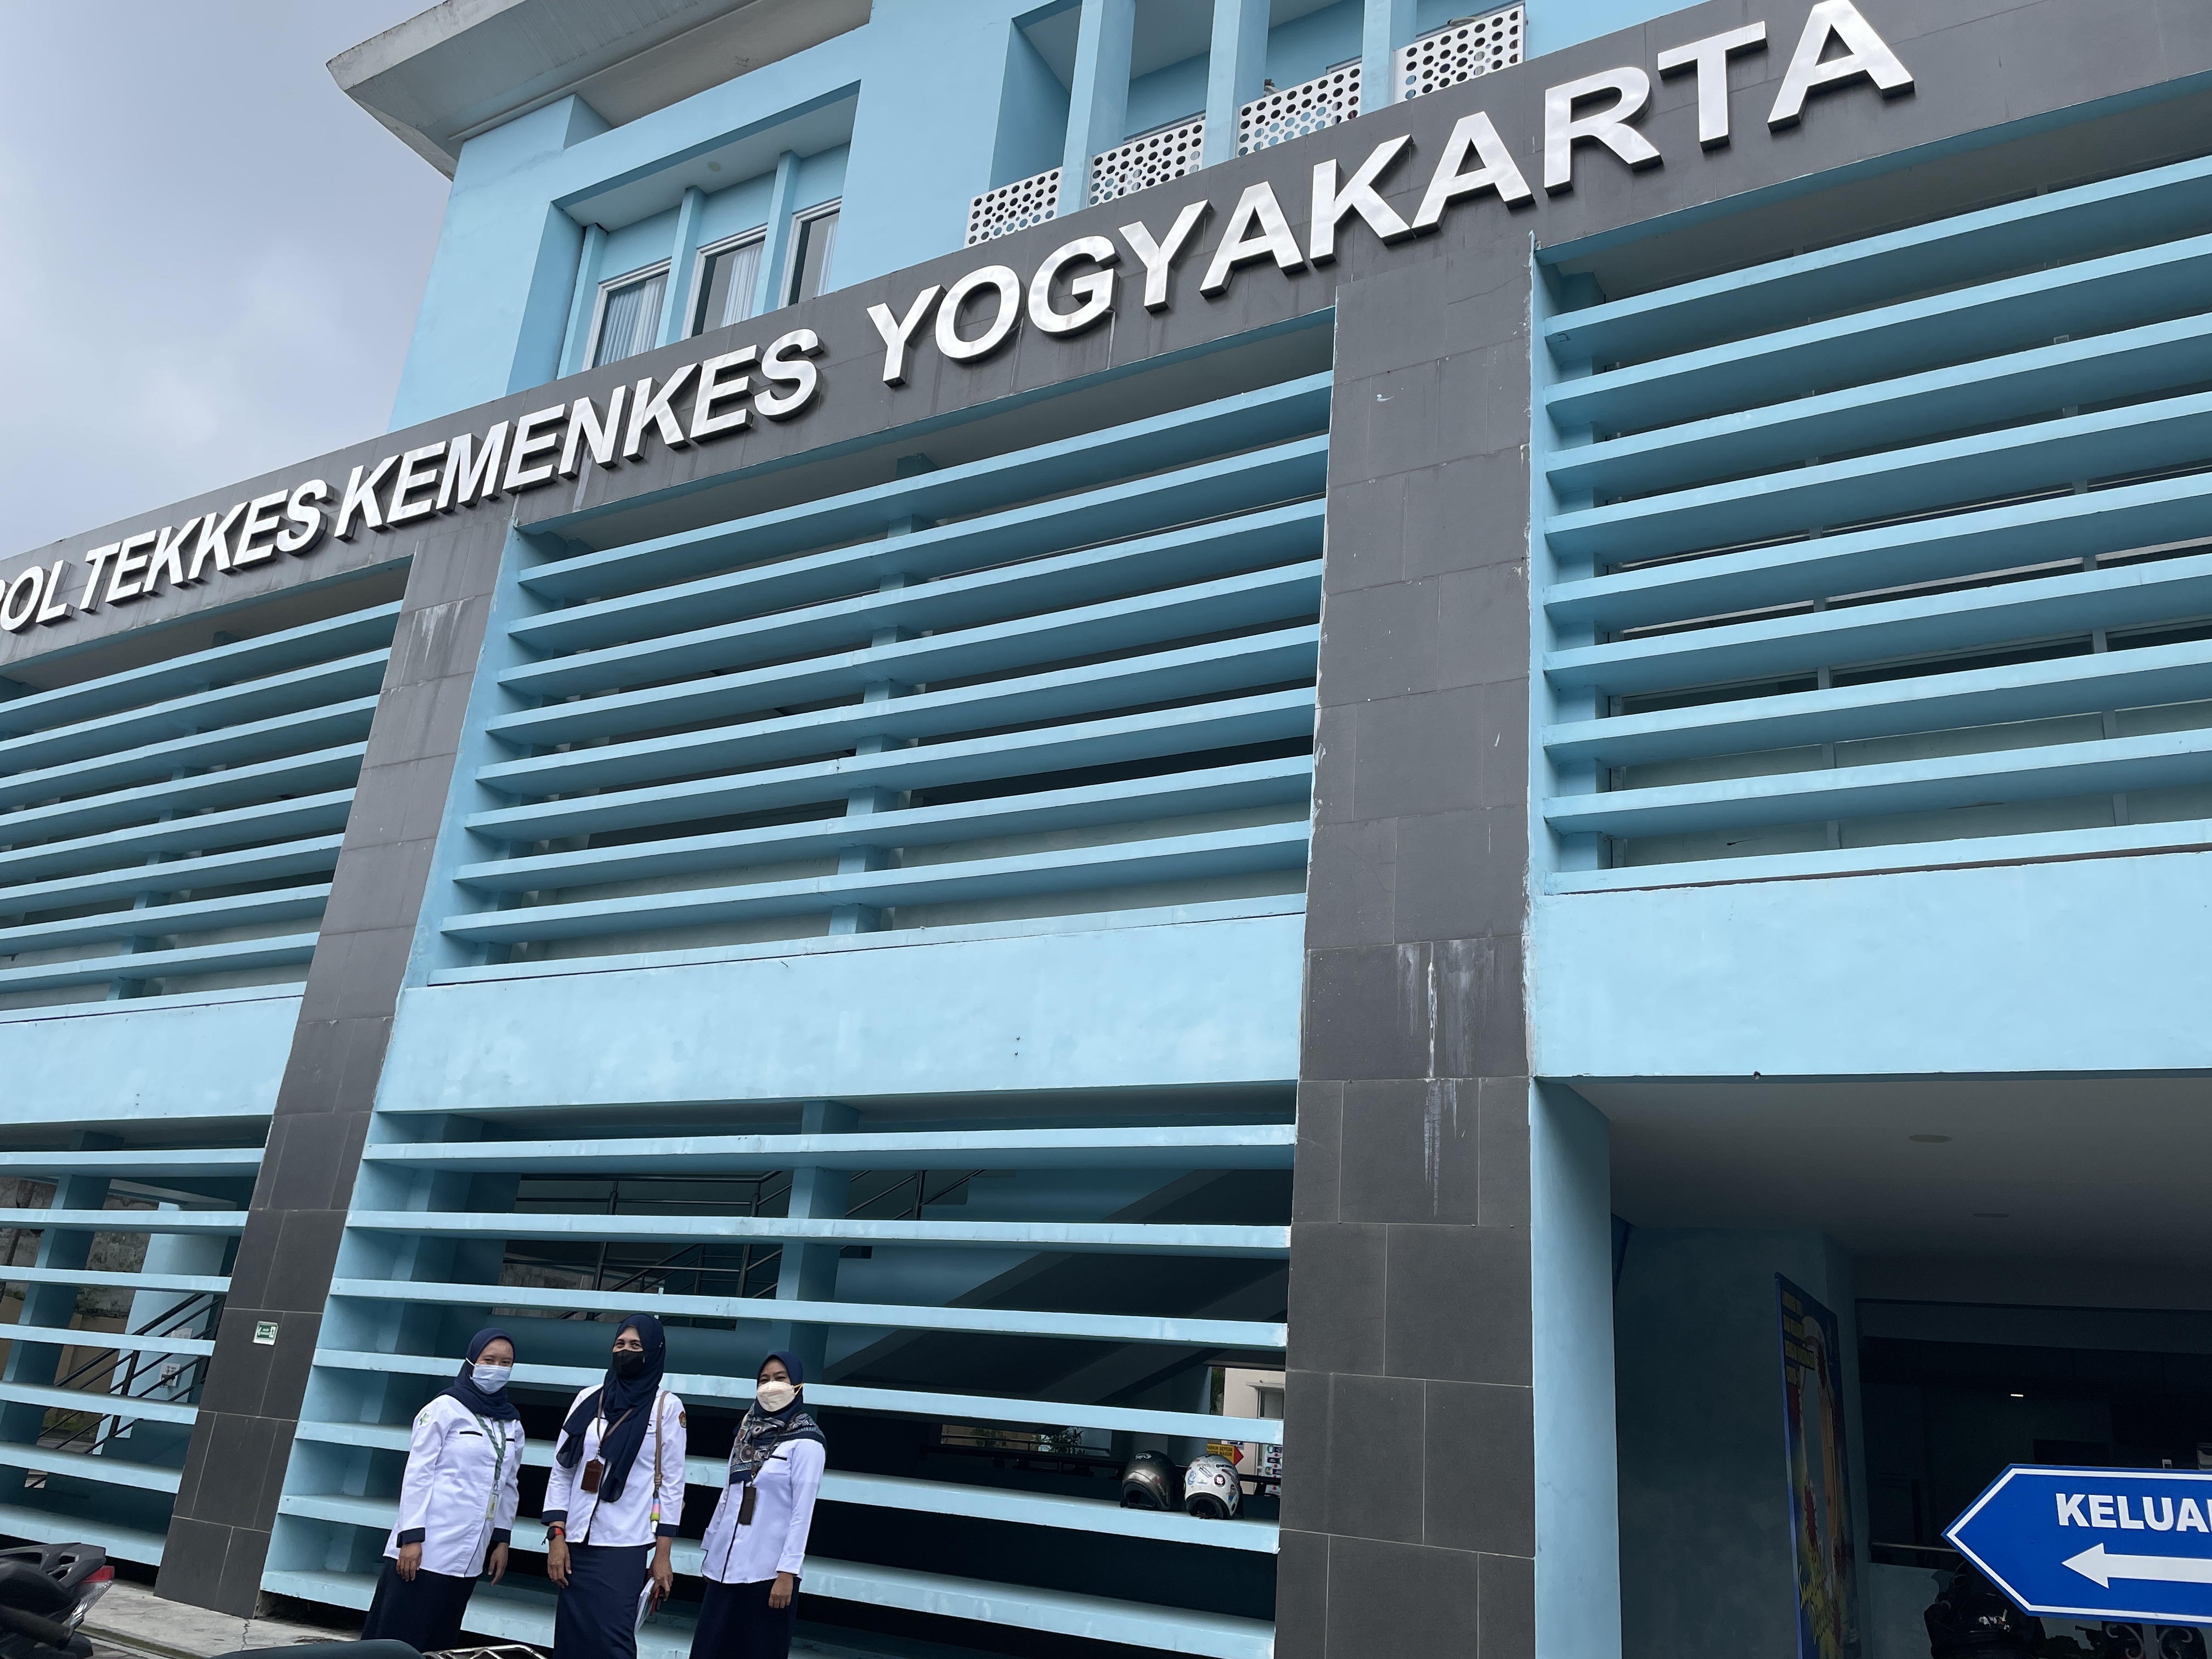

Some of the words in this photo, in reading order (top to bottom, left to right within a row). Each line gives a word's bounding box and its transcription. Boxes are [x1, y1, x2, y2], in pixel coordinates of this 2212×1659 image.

[334, 328, 823, 541] KEMENKES
[866, 0, 1915, 386] YOGYAKARTA
[2055, 1493, 2212, 1533] KELUA
